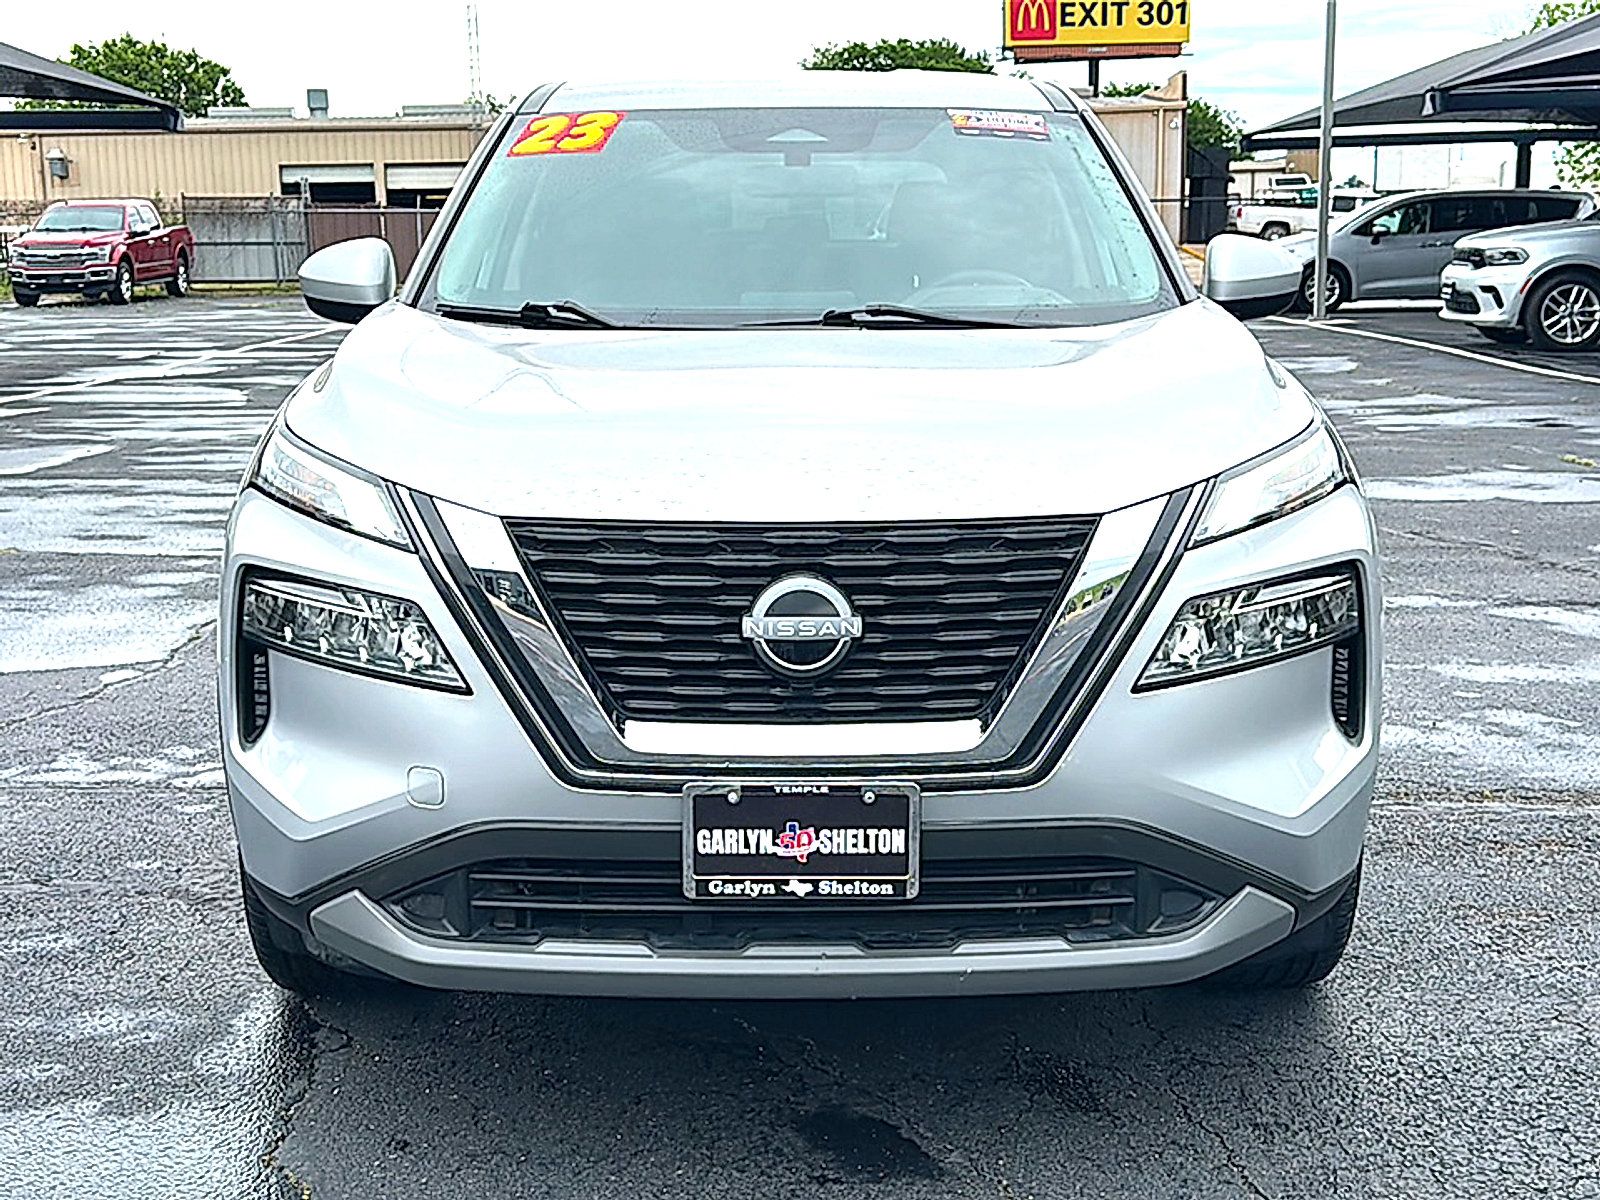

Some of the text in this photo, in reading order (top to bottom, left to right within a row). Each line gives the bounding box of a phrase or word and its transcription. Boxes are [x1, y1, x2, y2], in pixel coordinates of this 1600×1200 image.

[1060, 0, 1188, 26] EXIT 301
[510, 111, 619, 154] 23
[746, 621, 858, 636] NISSAN
[696, 828, 774, 854] GARLYN
[818, 828, 906, 854] SHELTON
[708, 880, 894, 898] Garlyn Shelton
